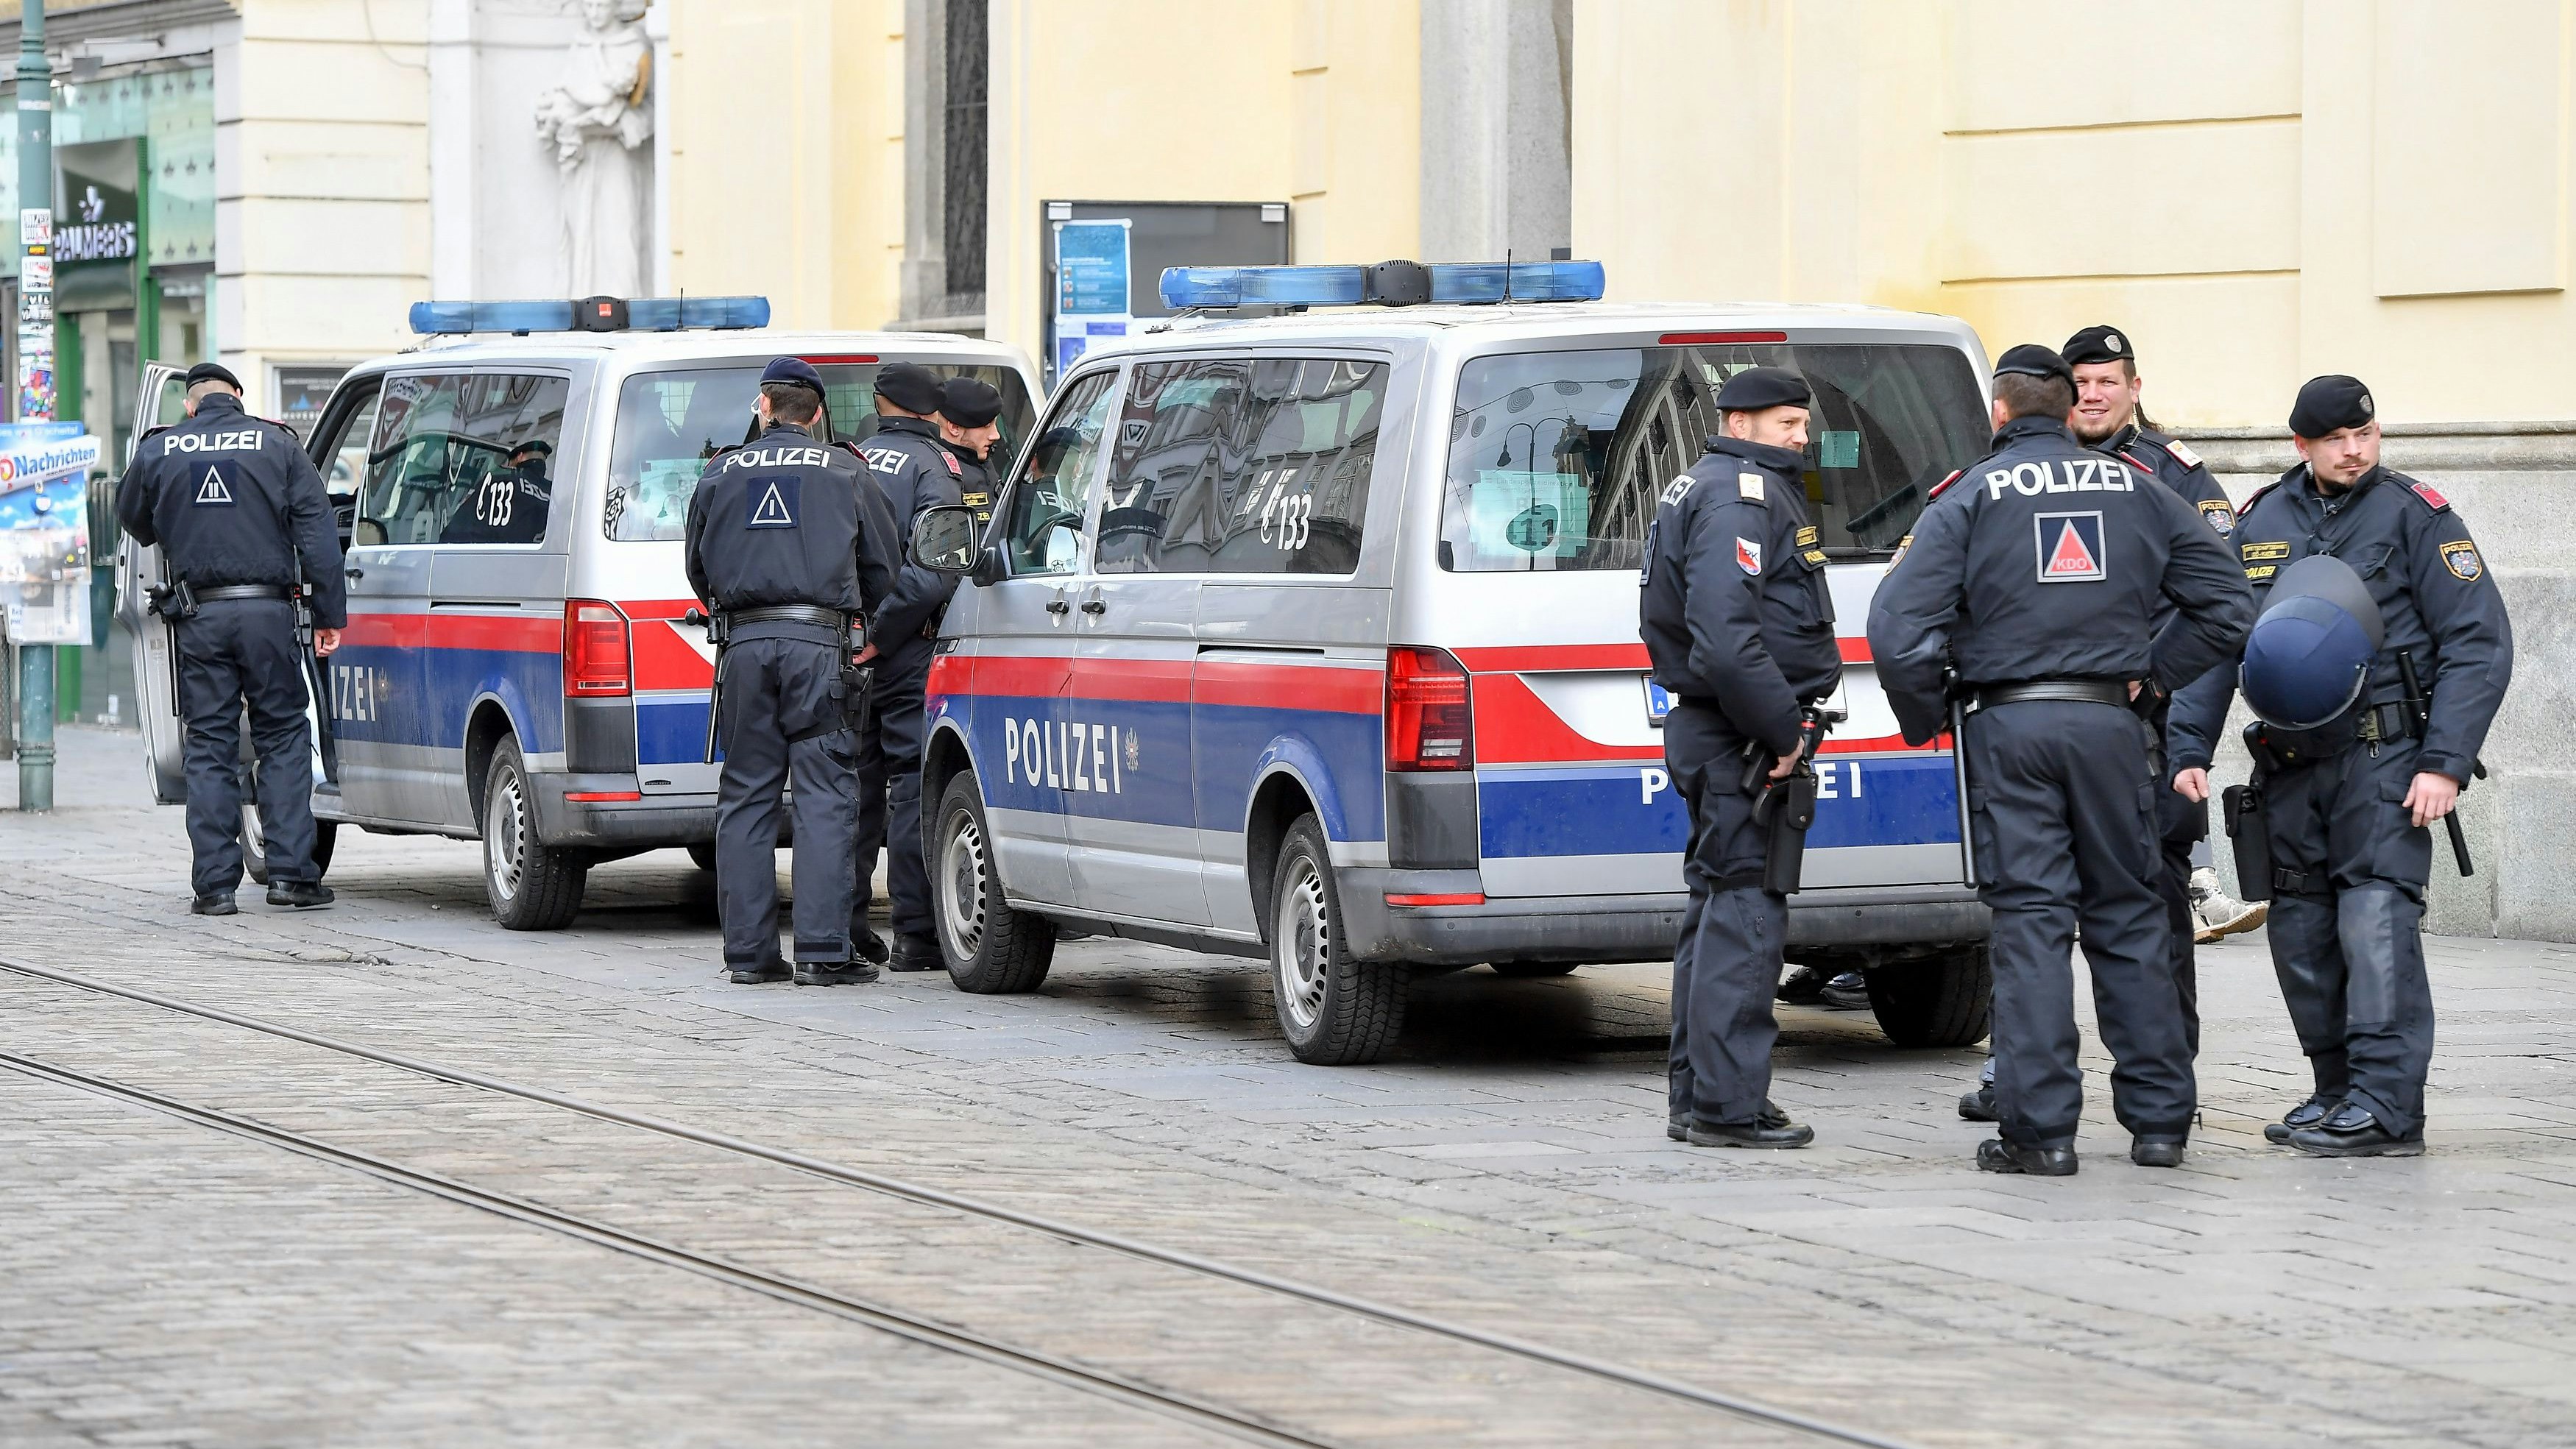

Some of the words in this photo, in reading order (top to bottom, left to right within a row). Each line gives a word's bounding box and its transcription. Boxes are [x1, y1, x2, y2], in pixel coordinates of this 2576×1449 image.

[163, 430, 263, 456] POLIZEI
[722, 447, 832, 475] POLIZEI
[1985, 459, 2134, 501] POLIZEI
[488, 481, 514, 527] 133
[1278, 493, 1312, 550] 133
[2056, 557, 2088, 570] KDO
[1656, 700, 1666, 710] A
[1005, 717, 1122, 795] POLIZEI
